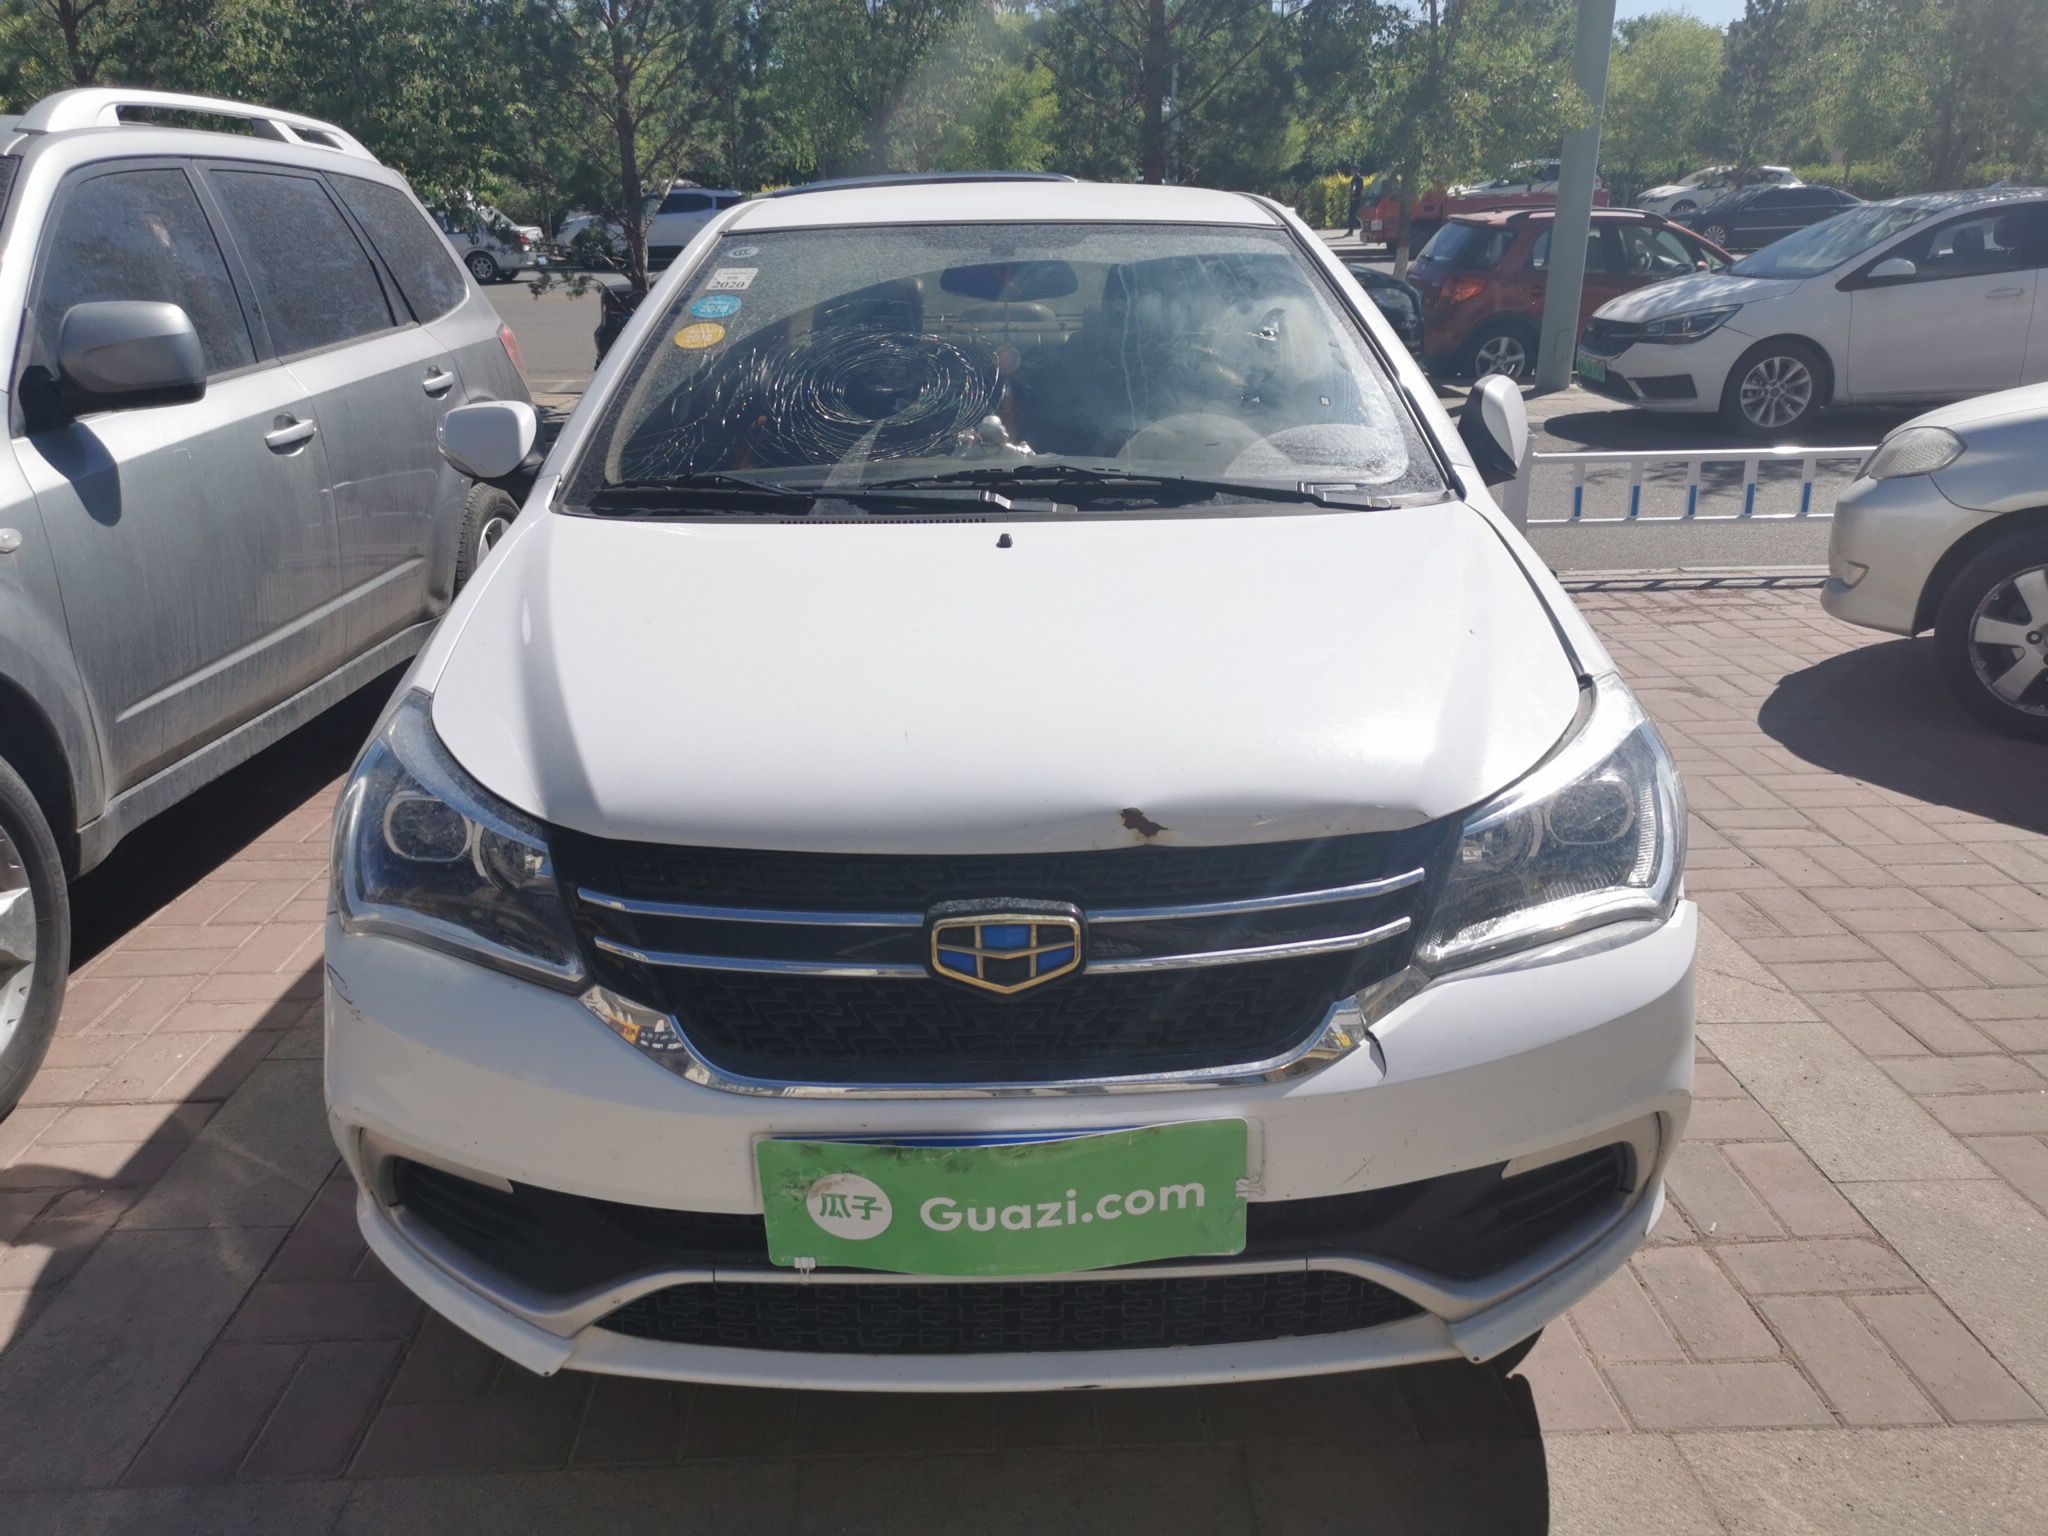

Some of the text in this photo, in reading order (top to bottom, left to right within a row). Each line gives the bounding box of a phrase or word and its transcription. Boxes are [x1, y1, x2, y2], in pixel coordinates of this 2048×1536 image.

[711, 281, 745, 289] 2020
[820, 1192, 883, 1221] 瓜子
[920, 1182, 1206, 1232] Guazi.com
